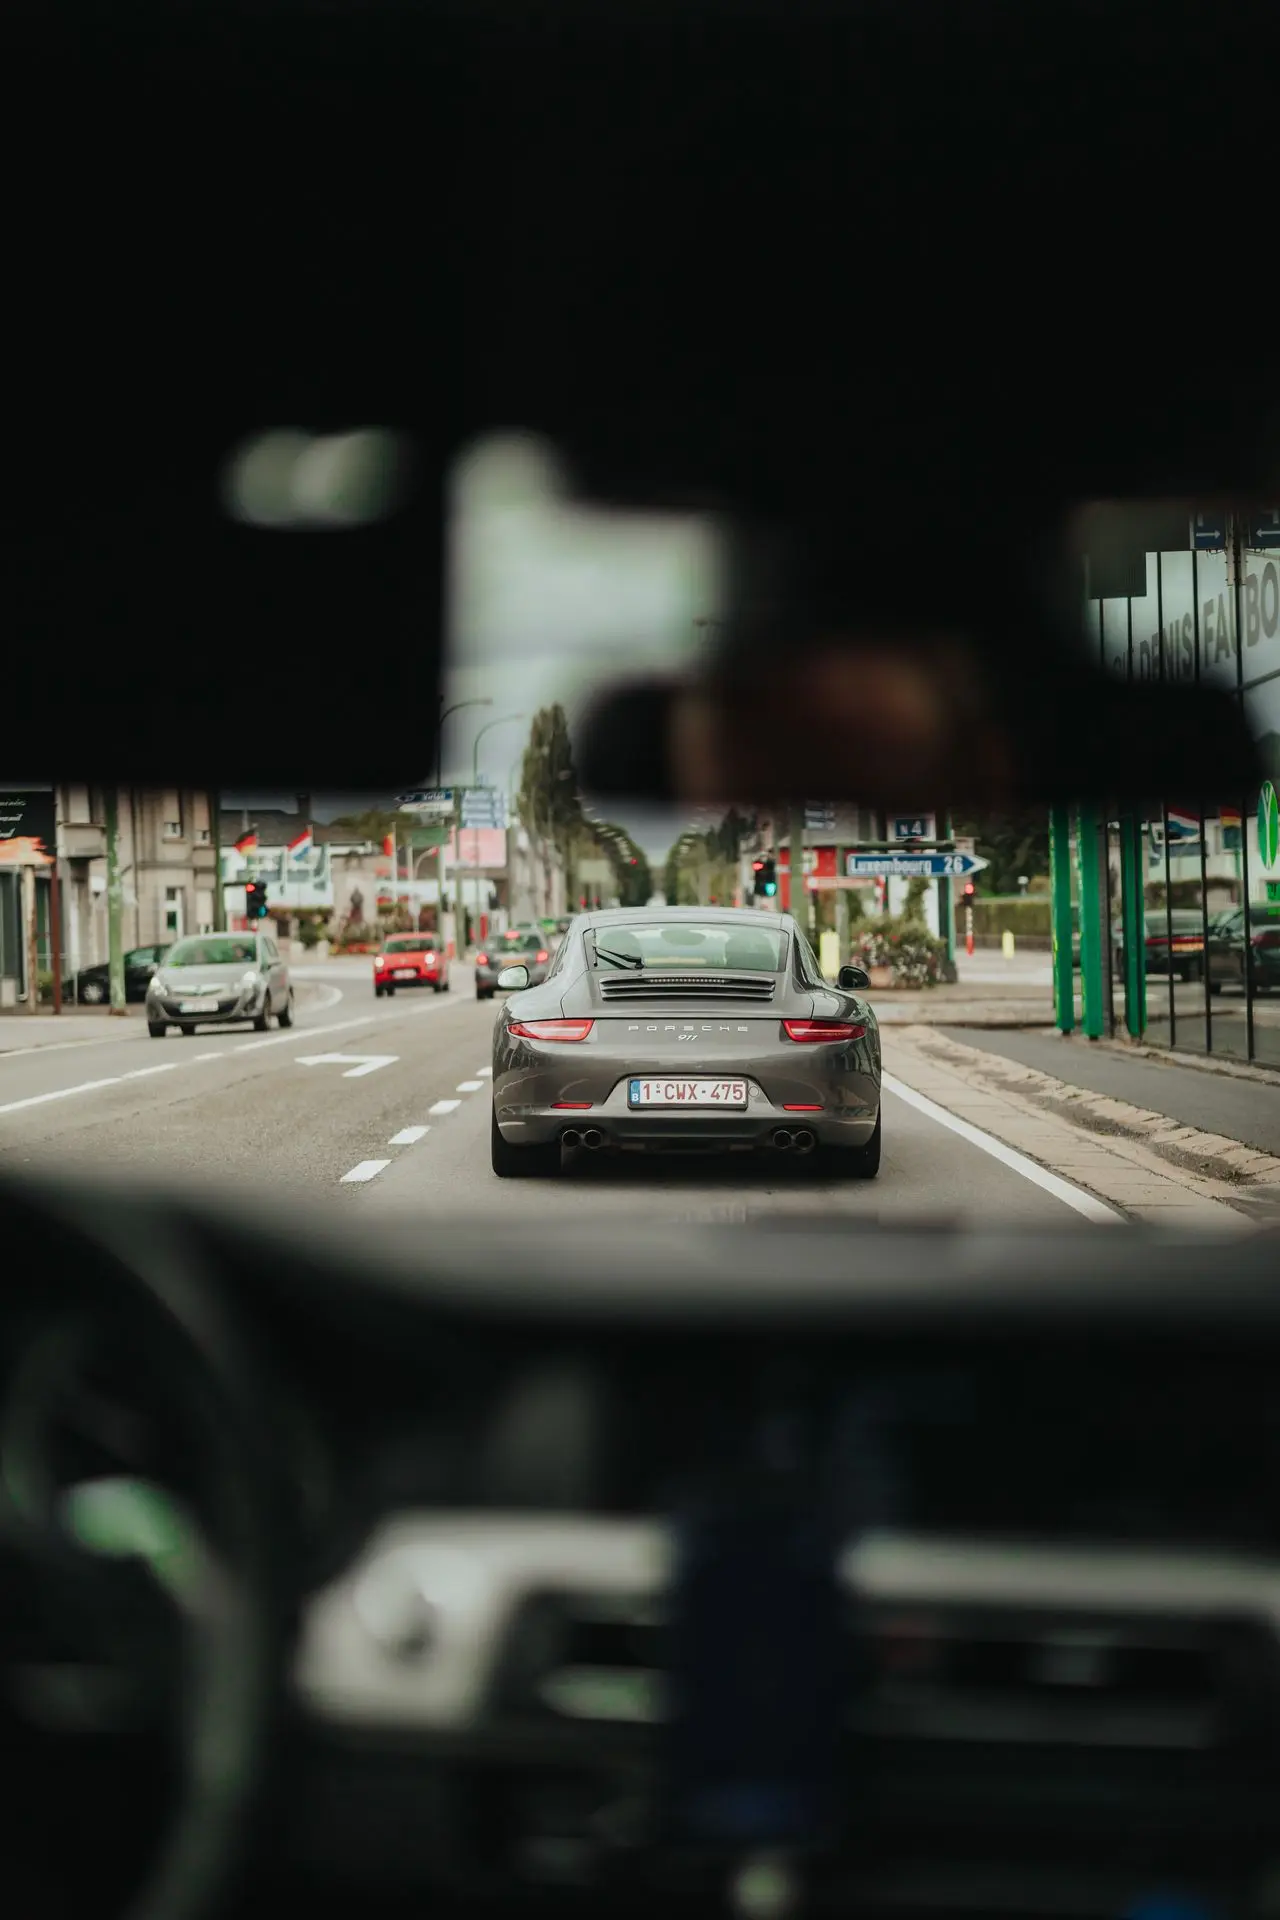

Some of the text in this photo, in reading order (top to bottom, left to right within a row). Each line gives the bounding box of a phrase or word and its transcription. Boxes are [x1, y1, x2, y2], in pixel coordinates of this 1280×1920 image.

[911, 820, 922, 834] 4
[850, 856, 964, 876] Luxembourg 26
[631, 1093, 639, 1102] B
